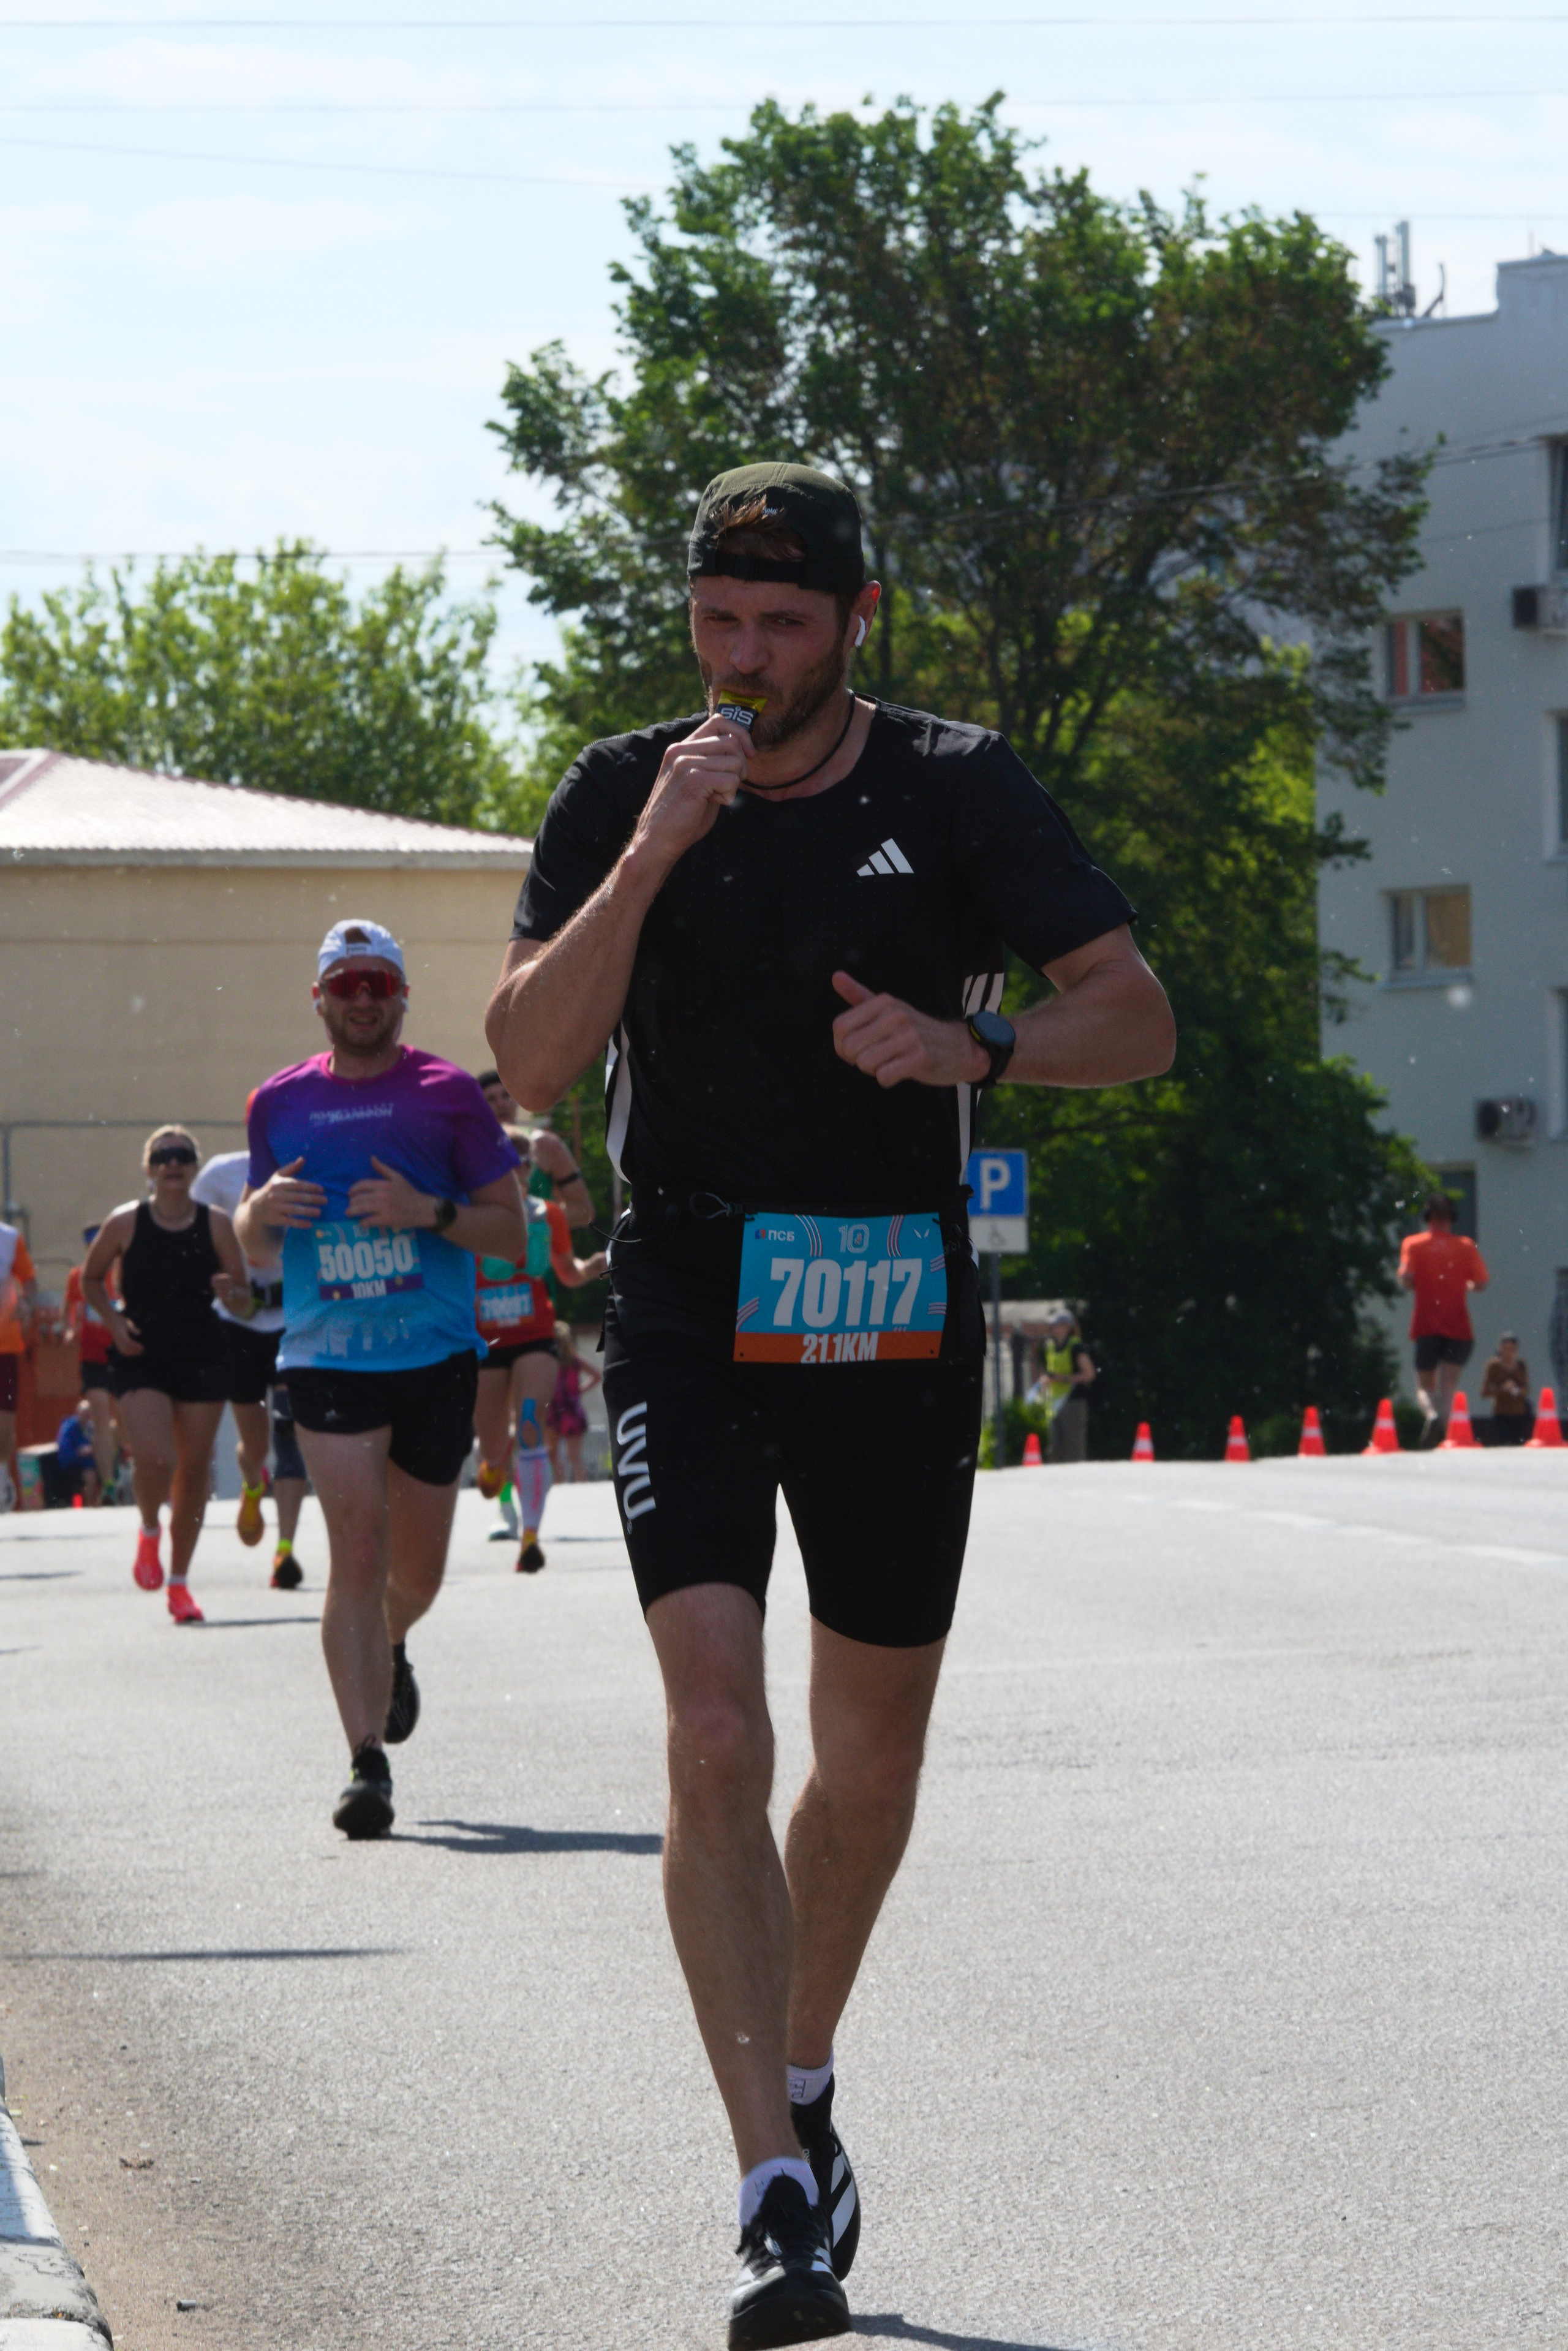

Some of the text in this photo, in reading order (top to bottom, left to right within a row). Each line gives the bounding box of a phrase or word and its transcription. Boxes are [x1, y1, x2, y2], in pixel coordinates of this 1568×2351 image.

[980, 1158, 1011, 1210] P
[318, 1234, 413, 1282] 50050
[768, 1229, 795, 1242] ПСБ
[770, 1258, 922, 1328] 70117
[801, 1332, 879, 1364] 21.1KM
